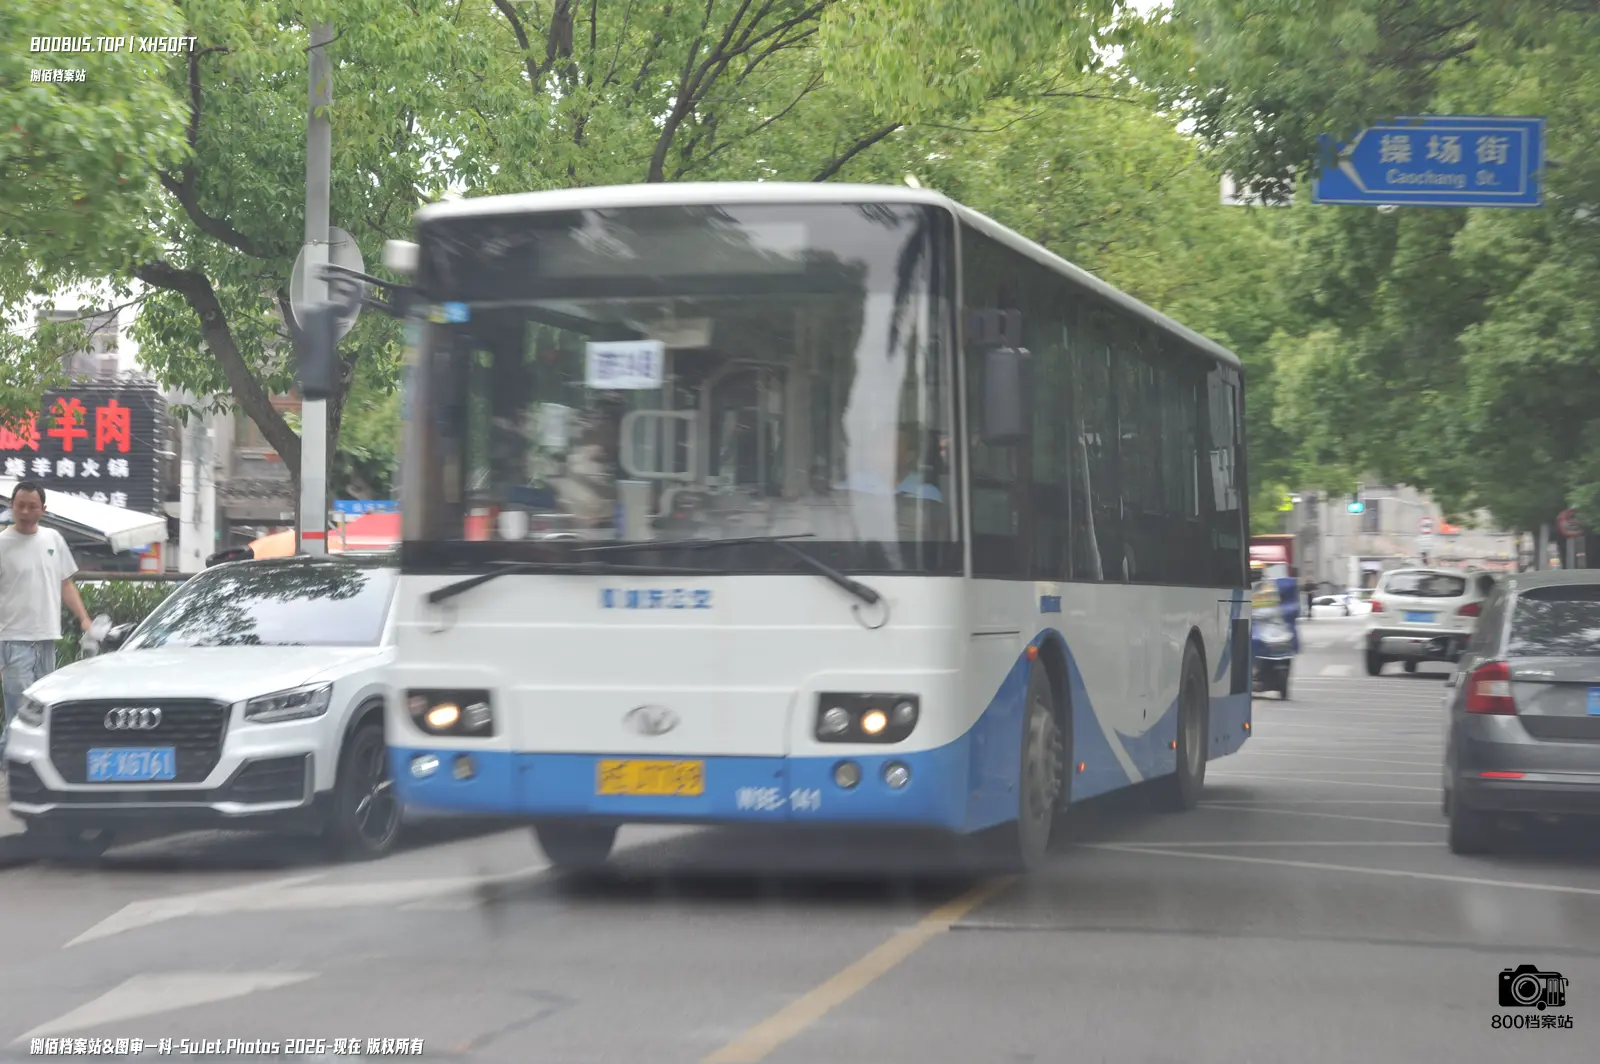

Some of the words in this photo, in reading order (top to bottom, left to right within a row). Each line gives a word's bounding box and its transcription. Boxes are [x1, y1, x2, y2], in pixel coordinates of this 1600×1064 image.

[1379, 134, 1510, 165] 操场街
[1386, 168, 1467, 189] Caochang
